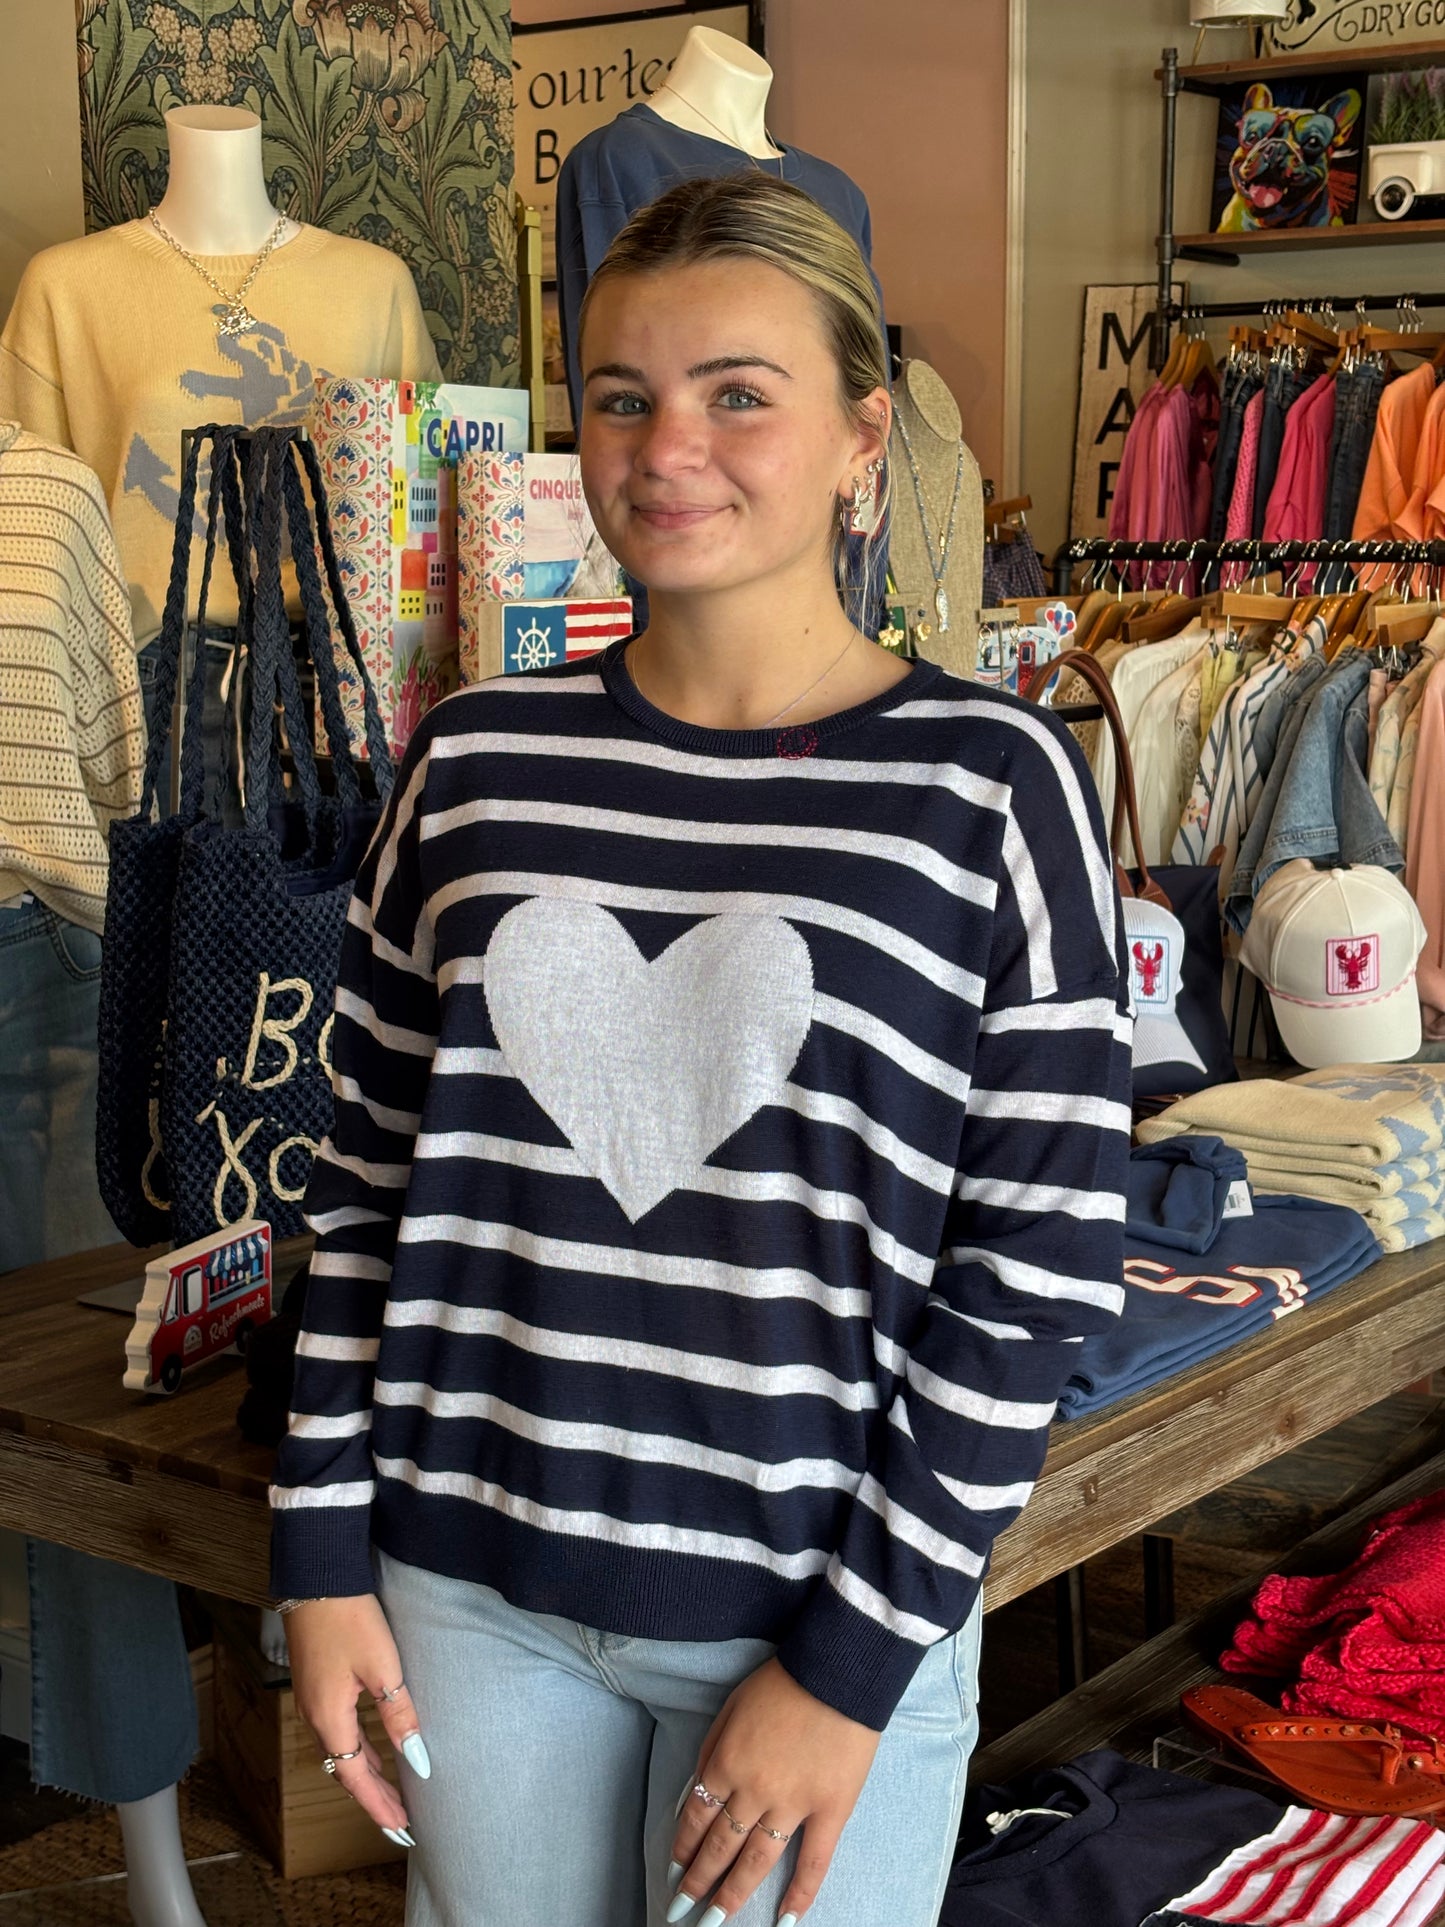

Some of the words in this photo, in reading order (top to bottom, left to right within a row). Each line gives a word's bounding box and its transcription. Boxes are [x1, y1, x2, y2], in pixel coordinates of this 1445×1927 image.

[512, 48, 676, 110] ourte
[427, 417, 504, 458] CAPRI
[530, 479, 581, 500] CINQUE
[209, 1293, 265, 1344] Refreshments
